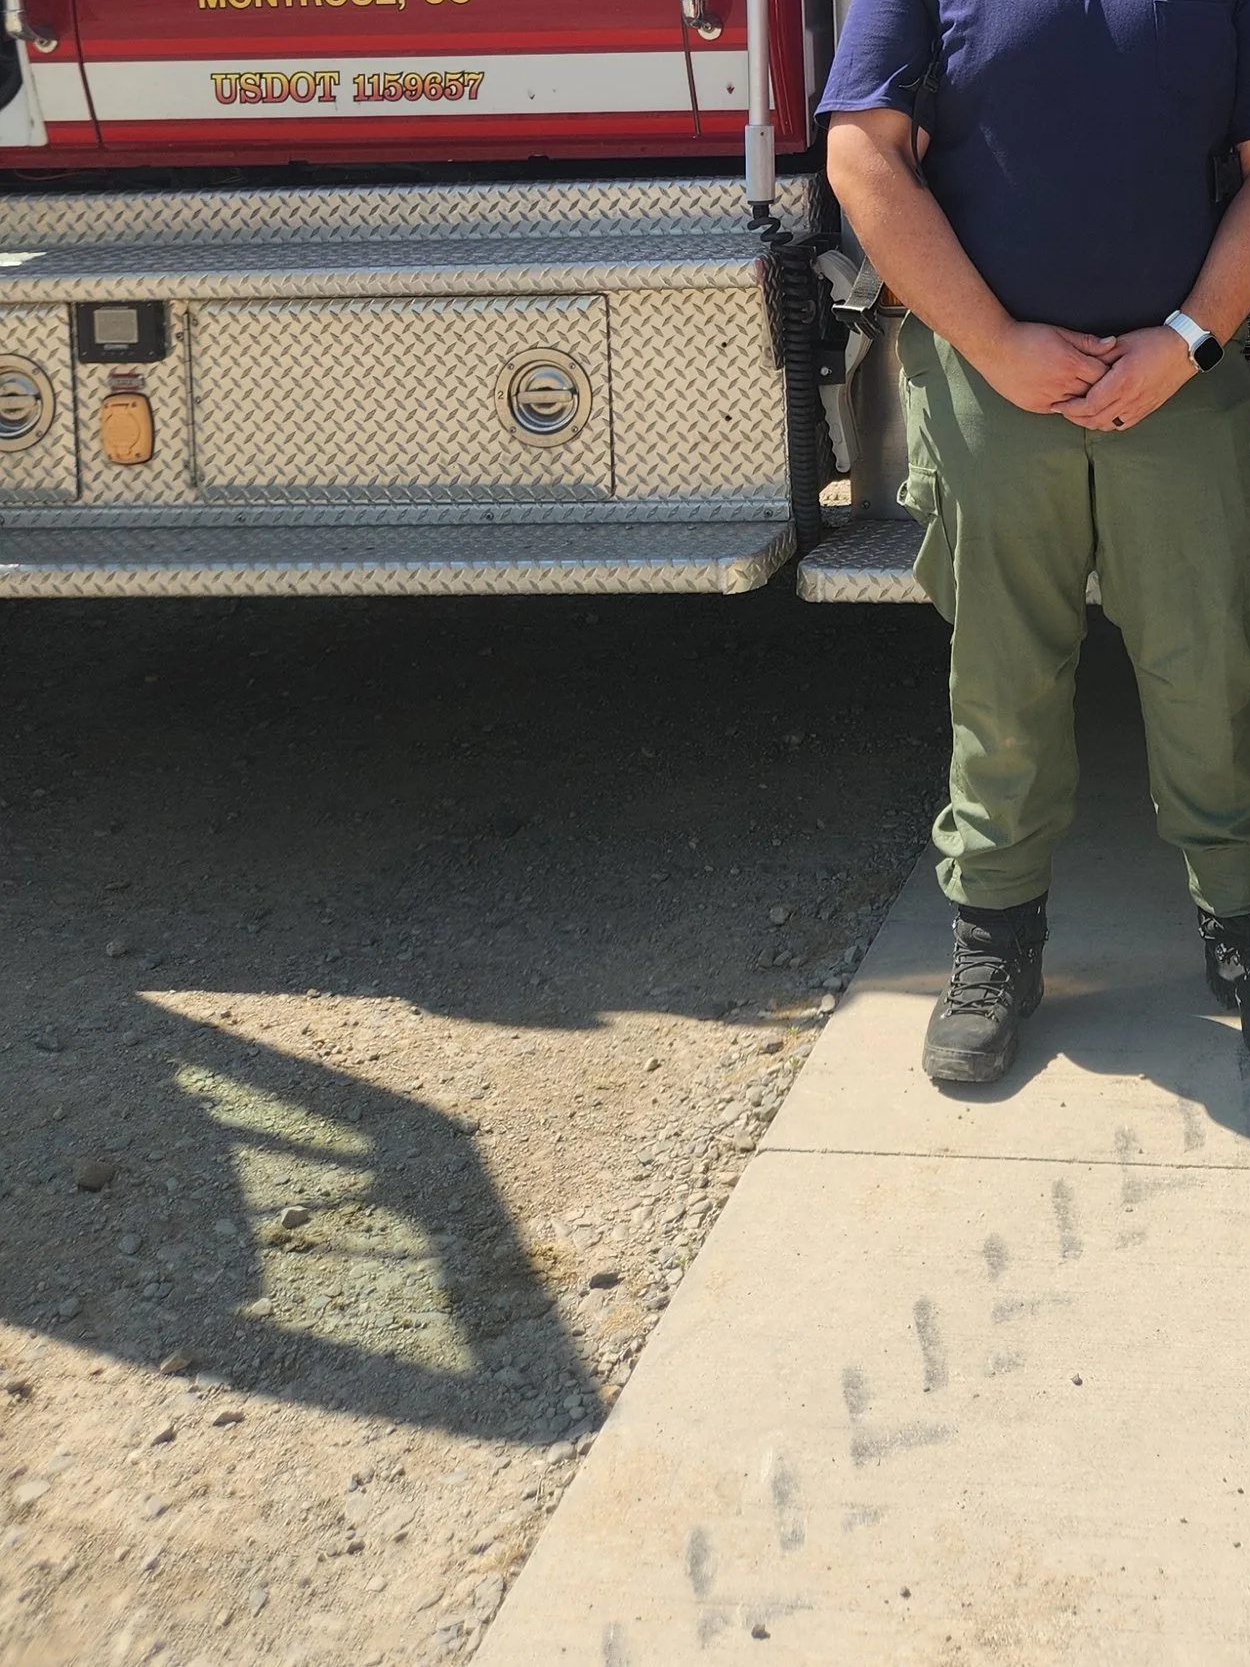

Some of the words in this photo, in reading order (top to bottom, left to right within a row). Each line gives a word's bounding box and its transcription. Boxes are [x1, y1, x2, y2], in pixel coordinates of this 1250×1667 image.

[210, 70, 340, 105] USDOT
[353, 69, 485, 102] 1159657
[497, 390, 505, 400] 2
